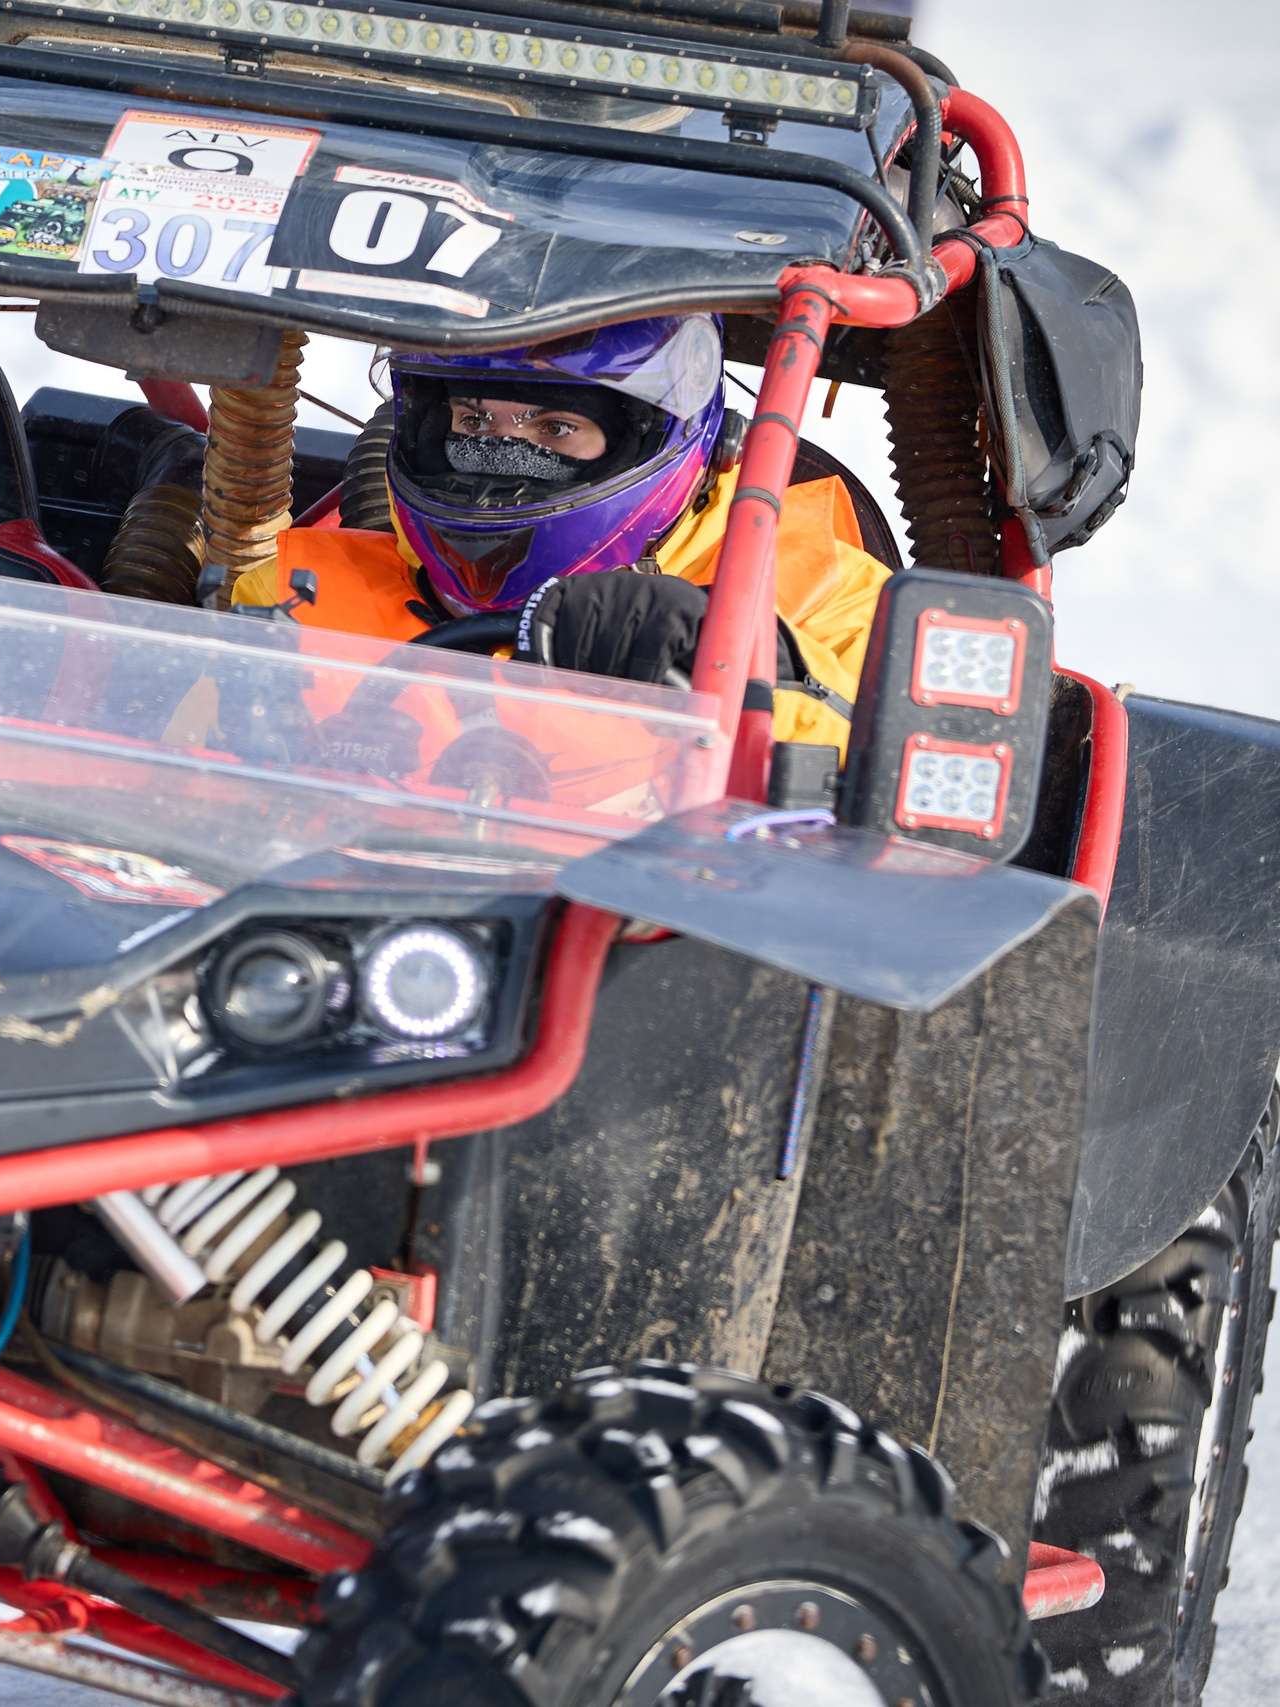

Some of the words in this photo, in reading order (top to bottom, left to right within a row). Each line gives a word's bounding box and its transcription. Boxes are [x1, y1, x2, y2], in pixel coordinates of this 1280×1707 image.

[164, 129, 269, 148] ATV
[116, 187, 160, 202] ATV
[192, 194, 279, 215] 2023
[366, 173, 484, 214] ZANZIBA
[93, 208, 278, 282] 307
[329, 190, 502, 278] 07
